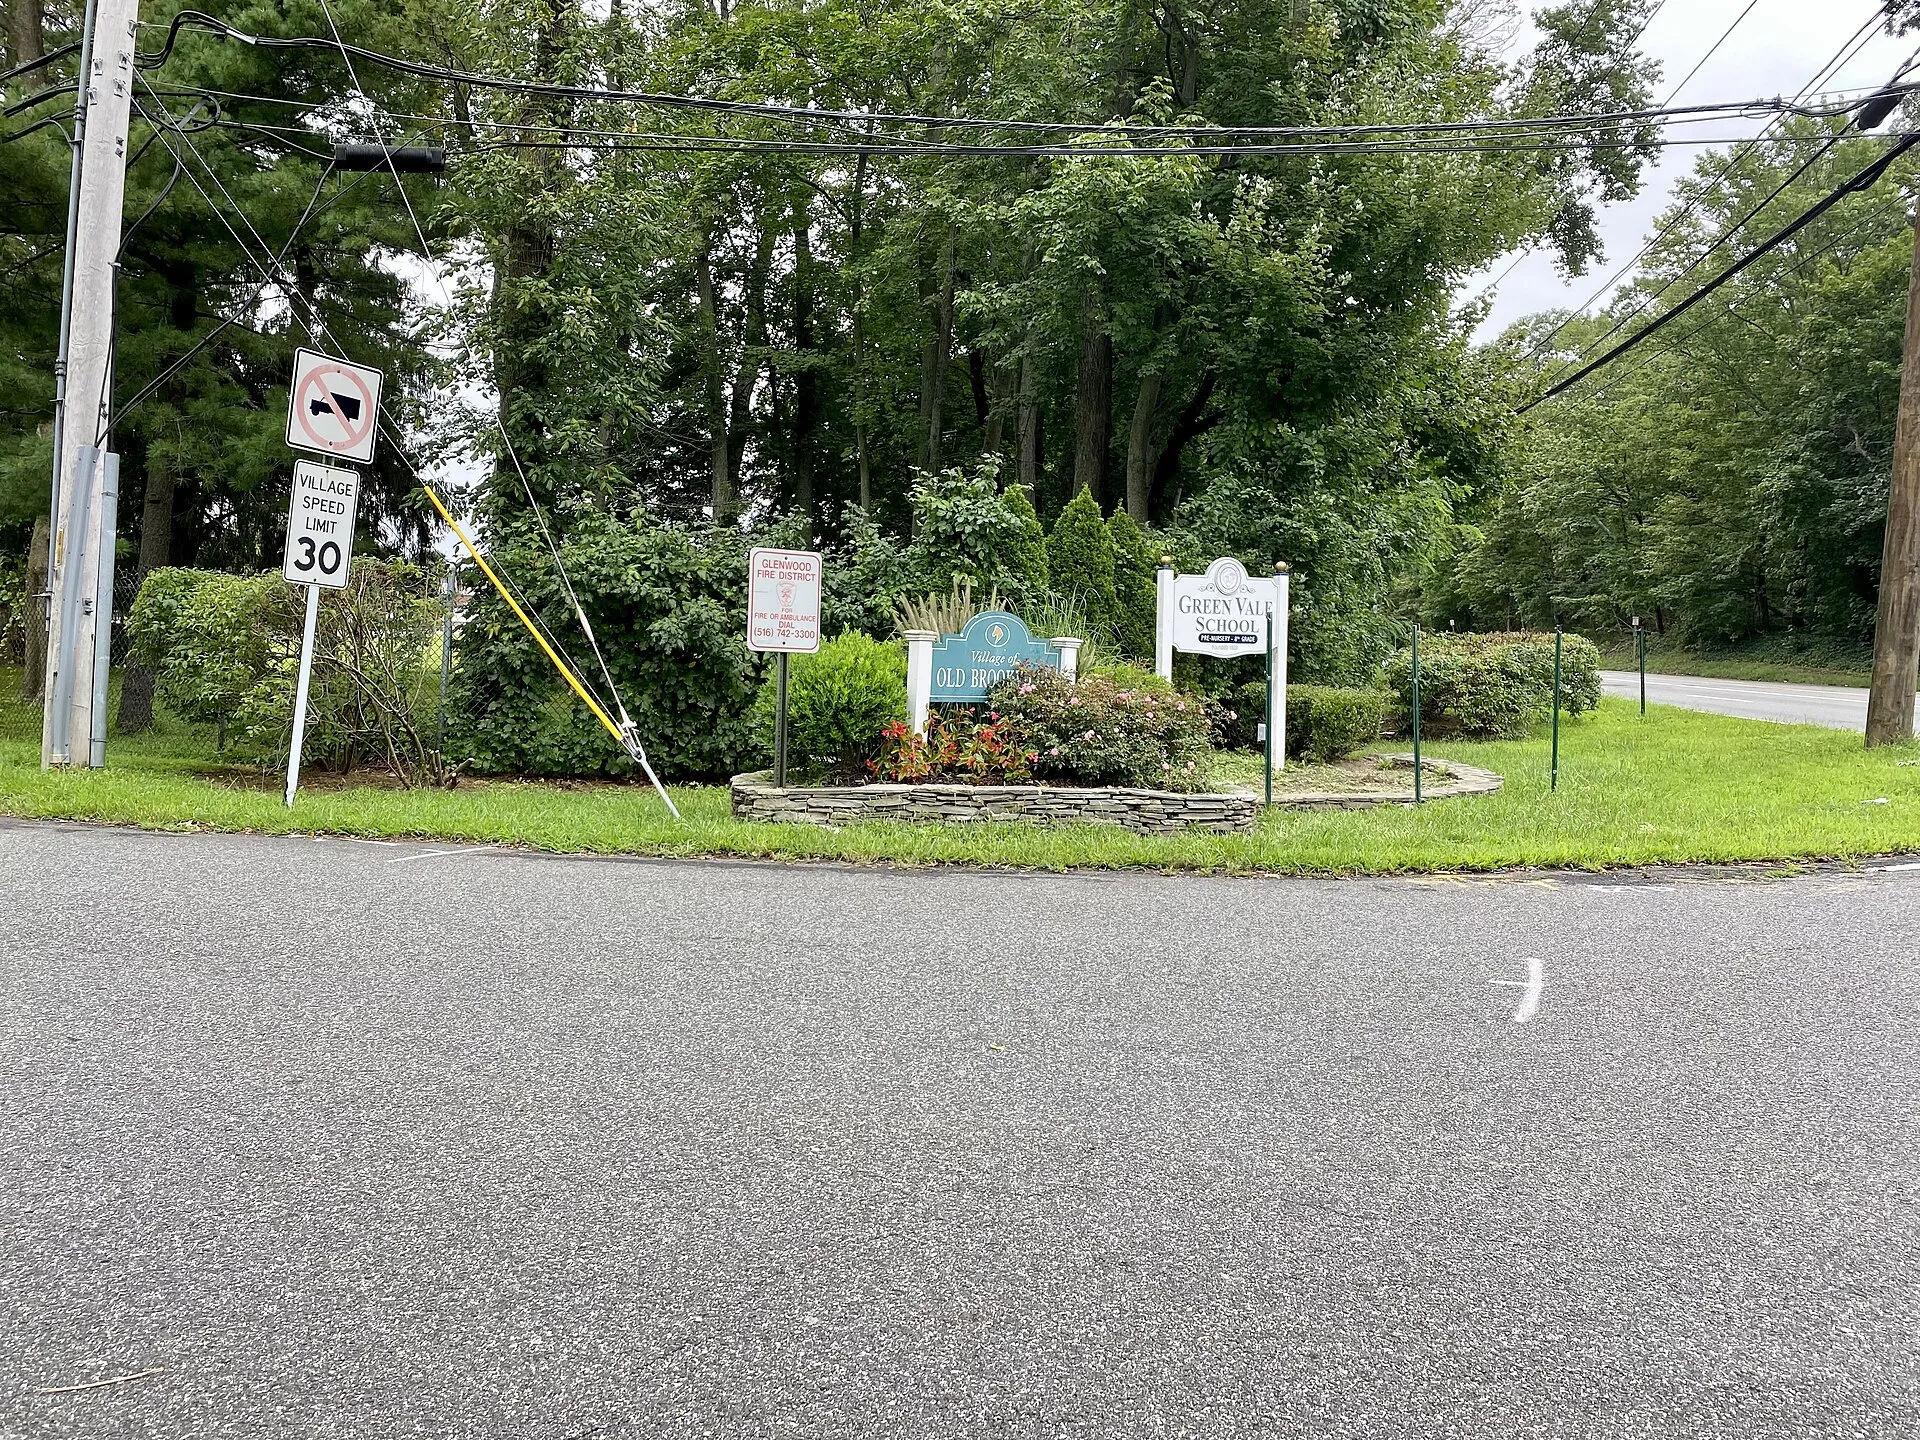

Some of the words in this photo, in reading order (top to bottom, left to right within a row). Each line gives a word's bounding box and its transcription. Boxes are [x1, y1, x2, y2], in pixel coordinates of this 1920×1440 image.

[300, 474, 353, 497] VILLAGE
[302, 495, 345, 515] SPEED
[305, 516, 338, 535] LIMIT
[293, 535, 342, 575] 30
[762, 559, 811, 571] GLENWOOD
[757, 570, 775, 578] FIRE
[779, 571, 816, 582] DISTRICT
[780, 614, 816, 622] AMBULANCE
[754, 628, 773, 637] (516)
[777, 629, 815, 638] 742-3300
[971, 650, 1006, 666] Village
[1007, 652, 1020, 667] of
[936, 667, 966, 688] OLD
